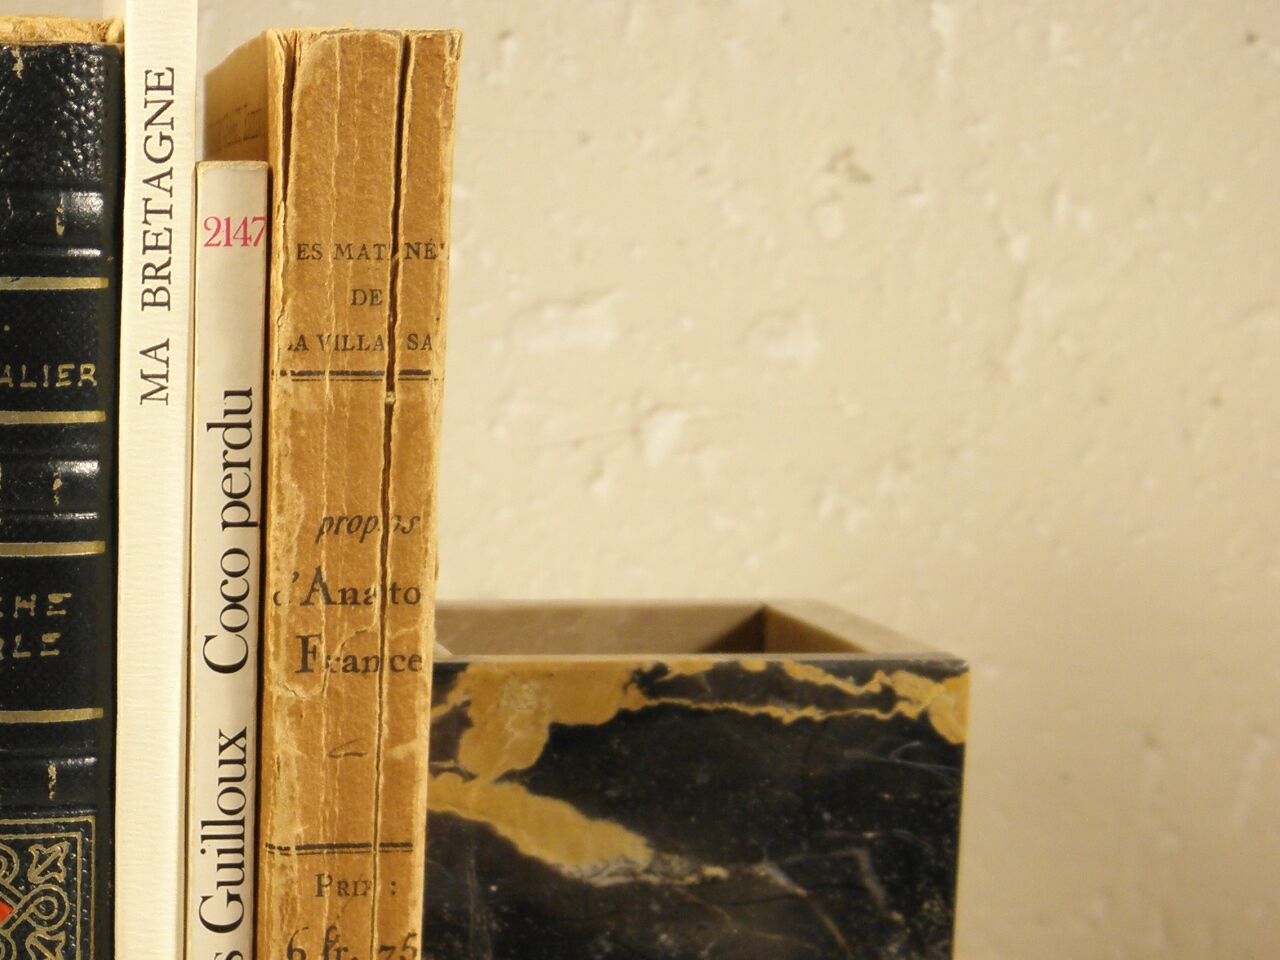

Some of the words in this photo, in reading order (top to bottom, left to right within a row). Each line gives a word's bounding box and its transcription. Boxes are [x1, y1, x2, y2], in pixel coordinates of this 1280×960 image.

[141, 66, 175, 312] BRETAGNE
[202, 216, 267, 247] 2147
[351, 289, 383, 306] DE
[139, 337, 171, 406] MA
[206, 386, 259, 532] perdu
[202, 547, 251, 674] Coco
[198, 725, 247, 934] Guilloux
